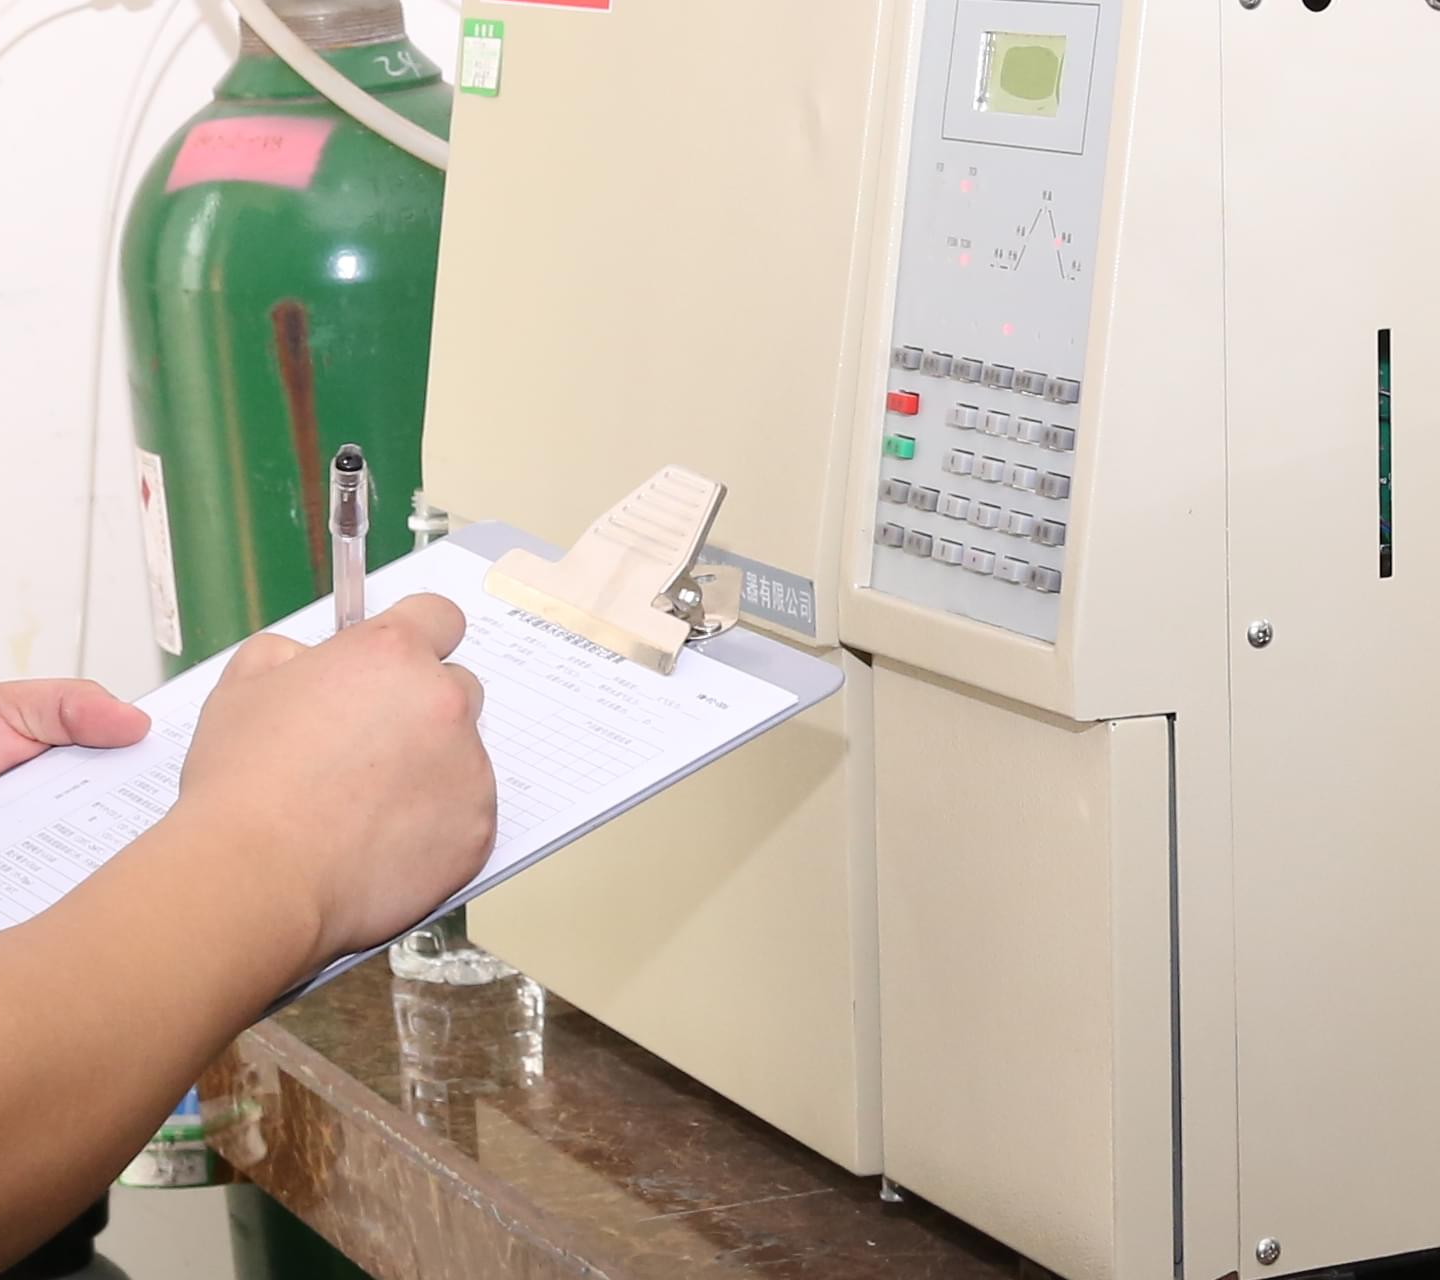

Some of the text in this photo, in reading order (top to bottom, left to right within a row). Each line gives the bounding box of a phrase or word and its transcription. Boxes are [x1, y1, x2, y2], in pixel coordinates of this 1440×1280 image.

[742, 571, 812, 624] 器有限公司
